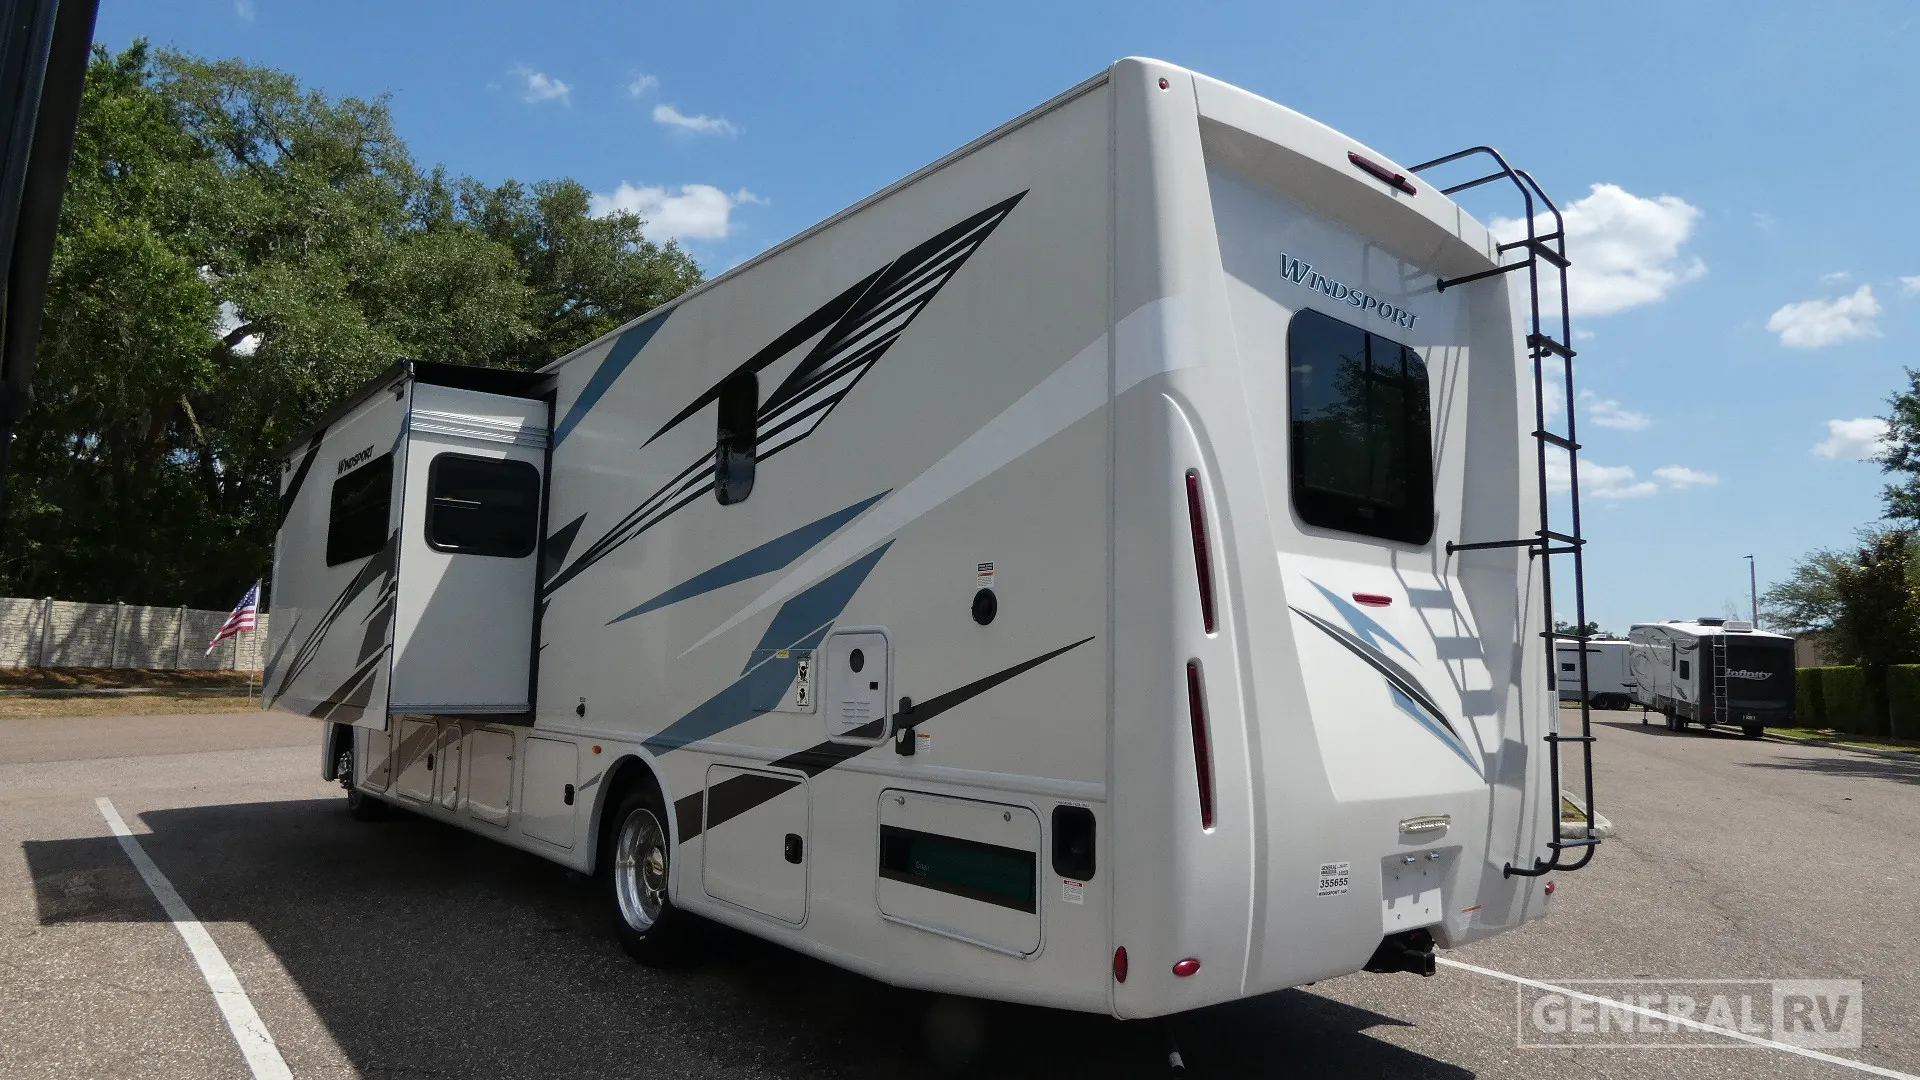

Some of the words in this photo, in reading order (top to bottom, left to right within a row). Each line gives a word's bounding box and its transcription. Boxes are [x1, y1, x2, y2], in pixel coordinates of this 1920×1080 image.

[1280, 251, 1420, 331] WINDSPORT
[337, 444, 375, 475] WINDSPORT
[1726, 668, 1773, 680] Infinity
[1319, 877, 1349, 888] 355655
